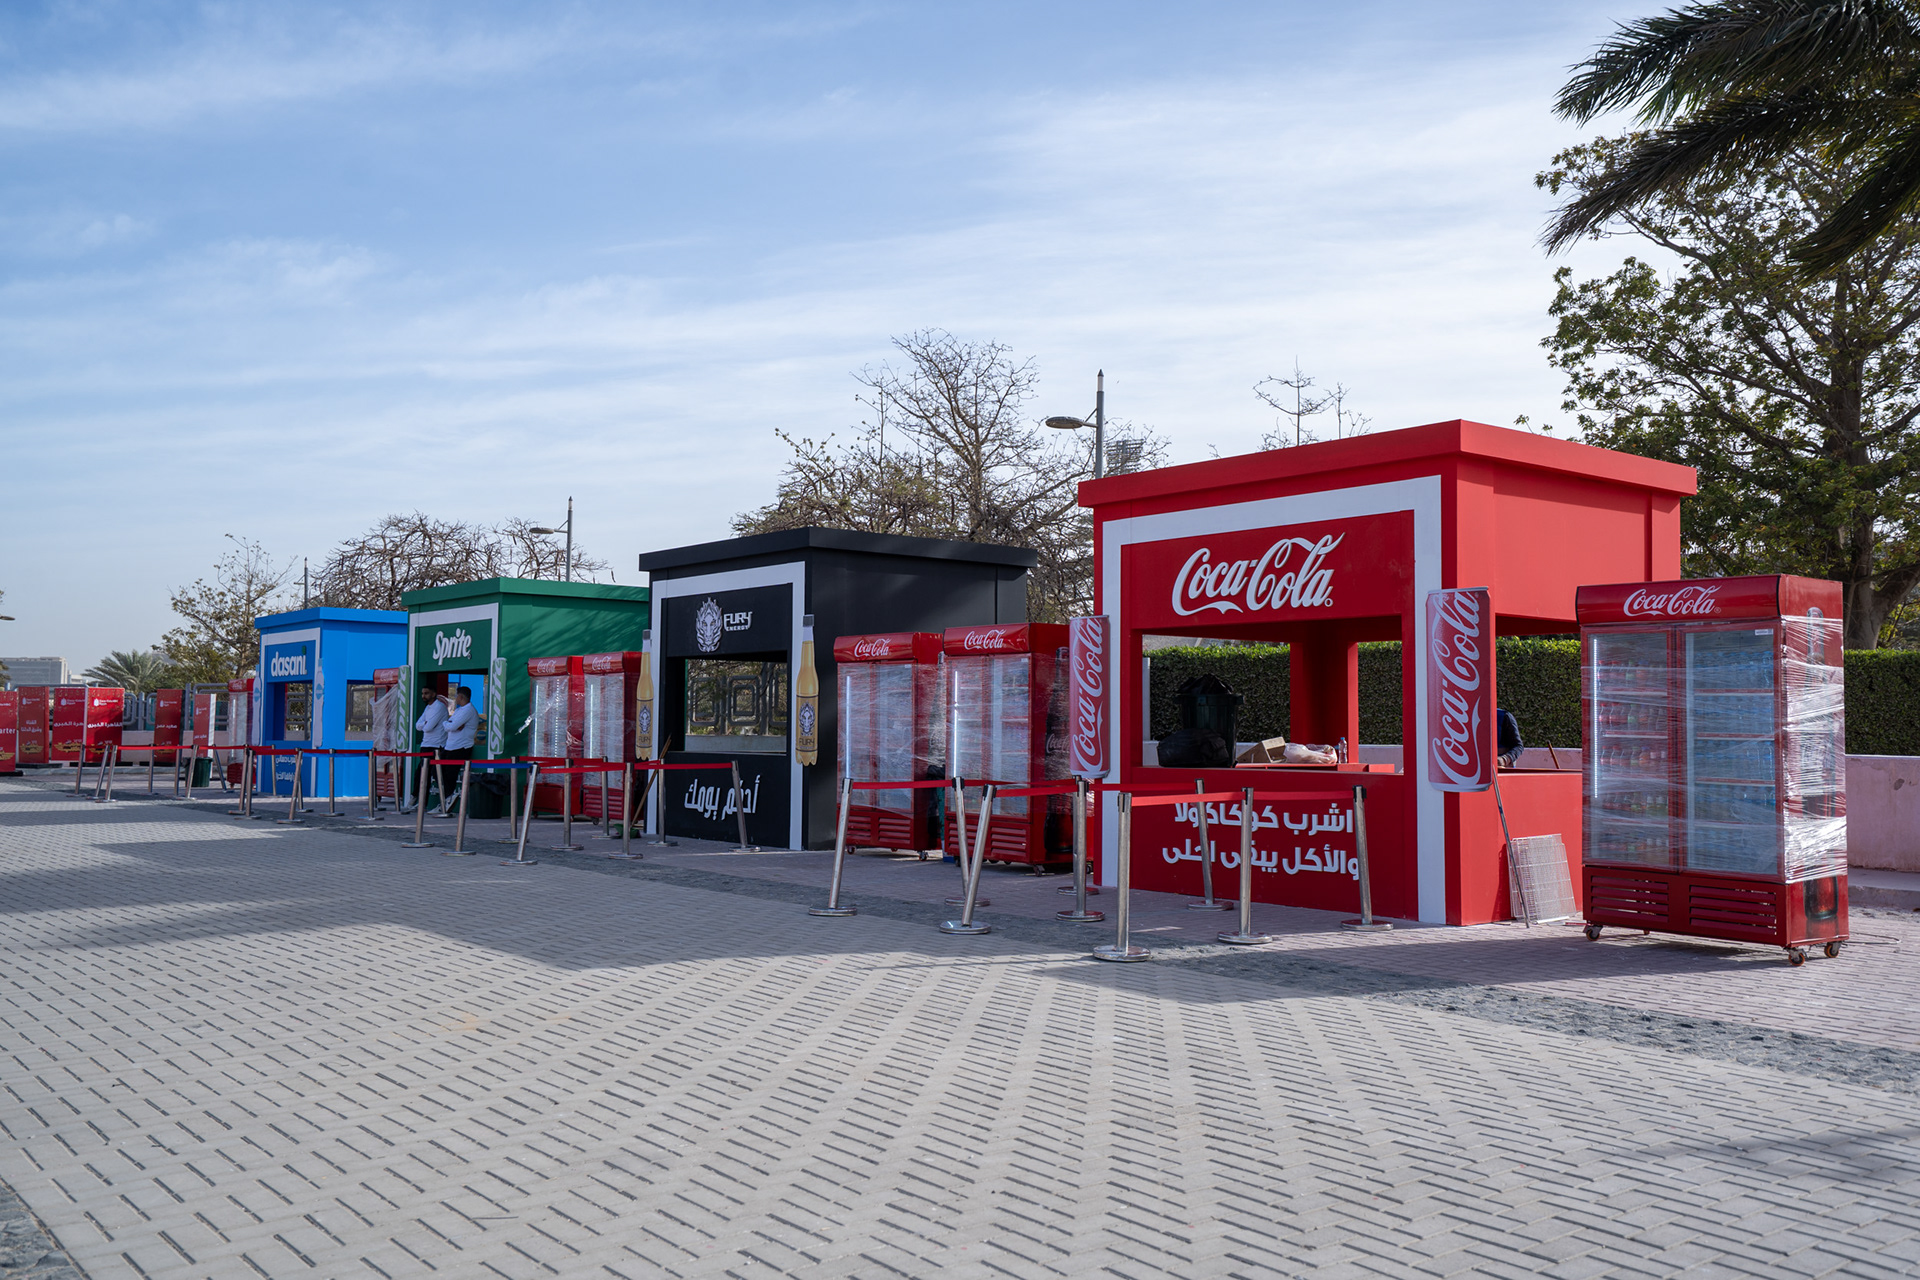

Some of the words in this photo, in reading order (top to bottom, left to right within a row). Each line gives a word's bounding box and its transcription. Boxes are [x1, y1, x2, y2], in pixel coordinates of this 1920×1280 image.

[1172, 532, 1345, 616] Coca-Cola
[1623, 585, 1722, 617] Coca-Cola
[724, 611, 752, 631] FURY
[432, 628, 472, 666] Sprite
[854, 638, 890, 658] Coca-Cola
[964, 629, 1006, 650] Coca-Cola
[271, 645, 307, 677] dasani
[1072, 617, 1103, 773] Coca-Cola
[1433, 588, 1481, 785] Coca-Cola
[490, 660, 503, 753] Sprite
[684, 779, 720, 820] يومك
[1174, 802, 1279, 832] كوكاكولا
[1283, 803, 1353, 836] اشرب
[1220, 840, 1278, 873] يبقى
[1282, 844, 1360, 880] والأكل
